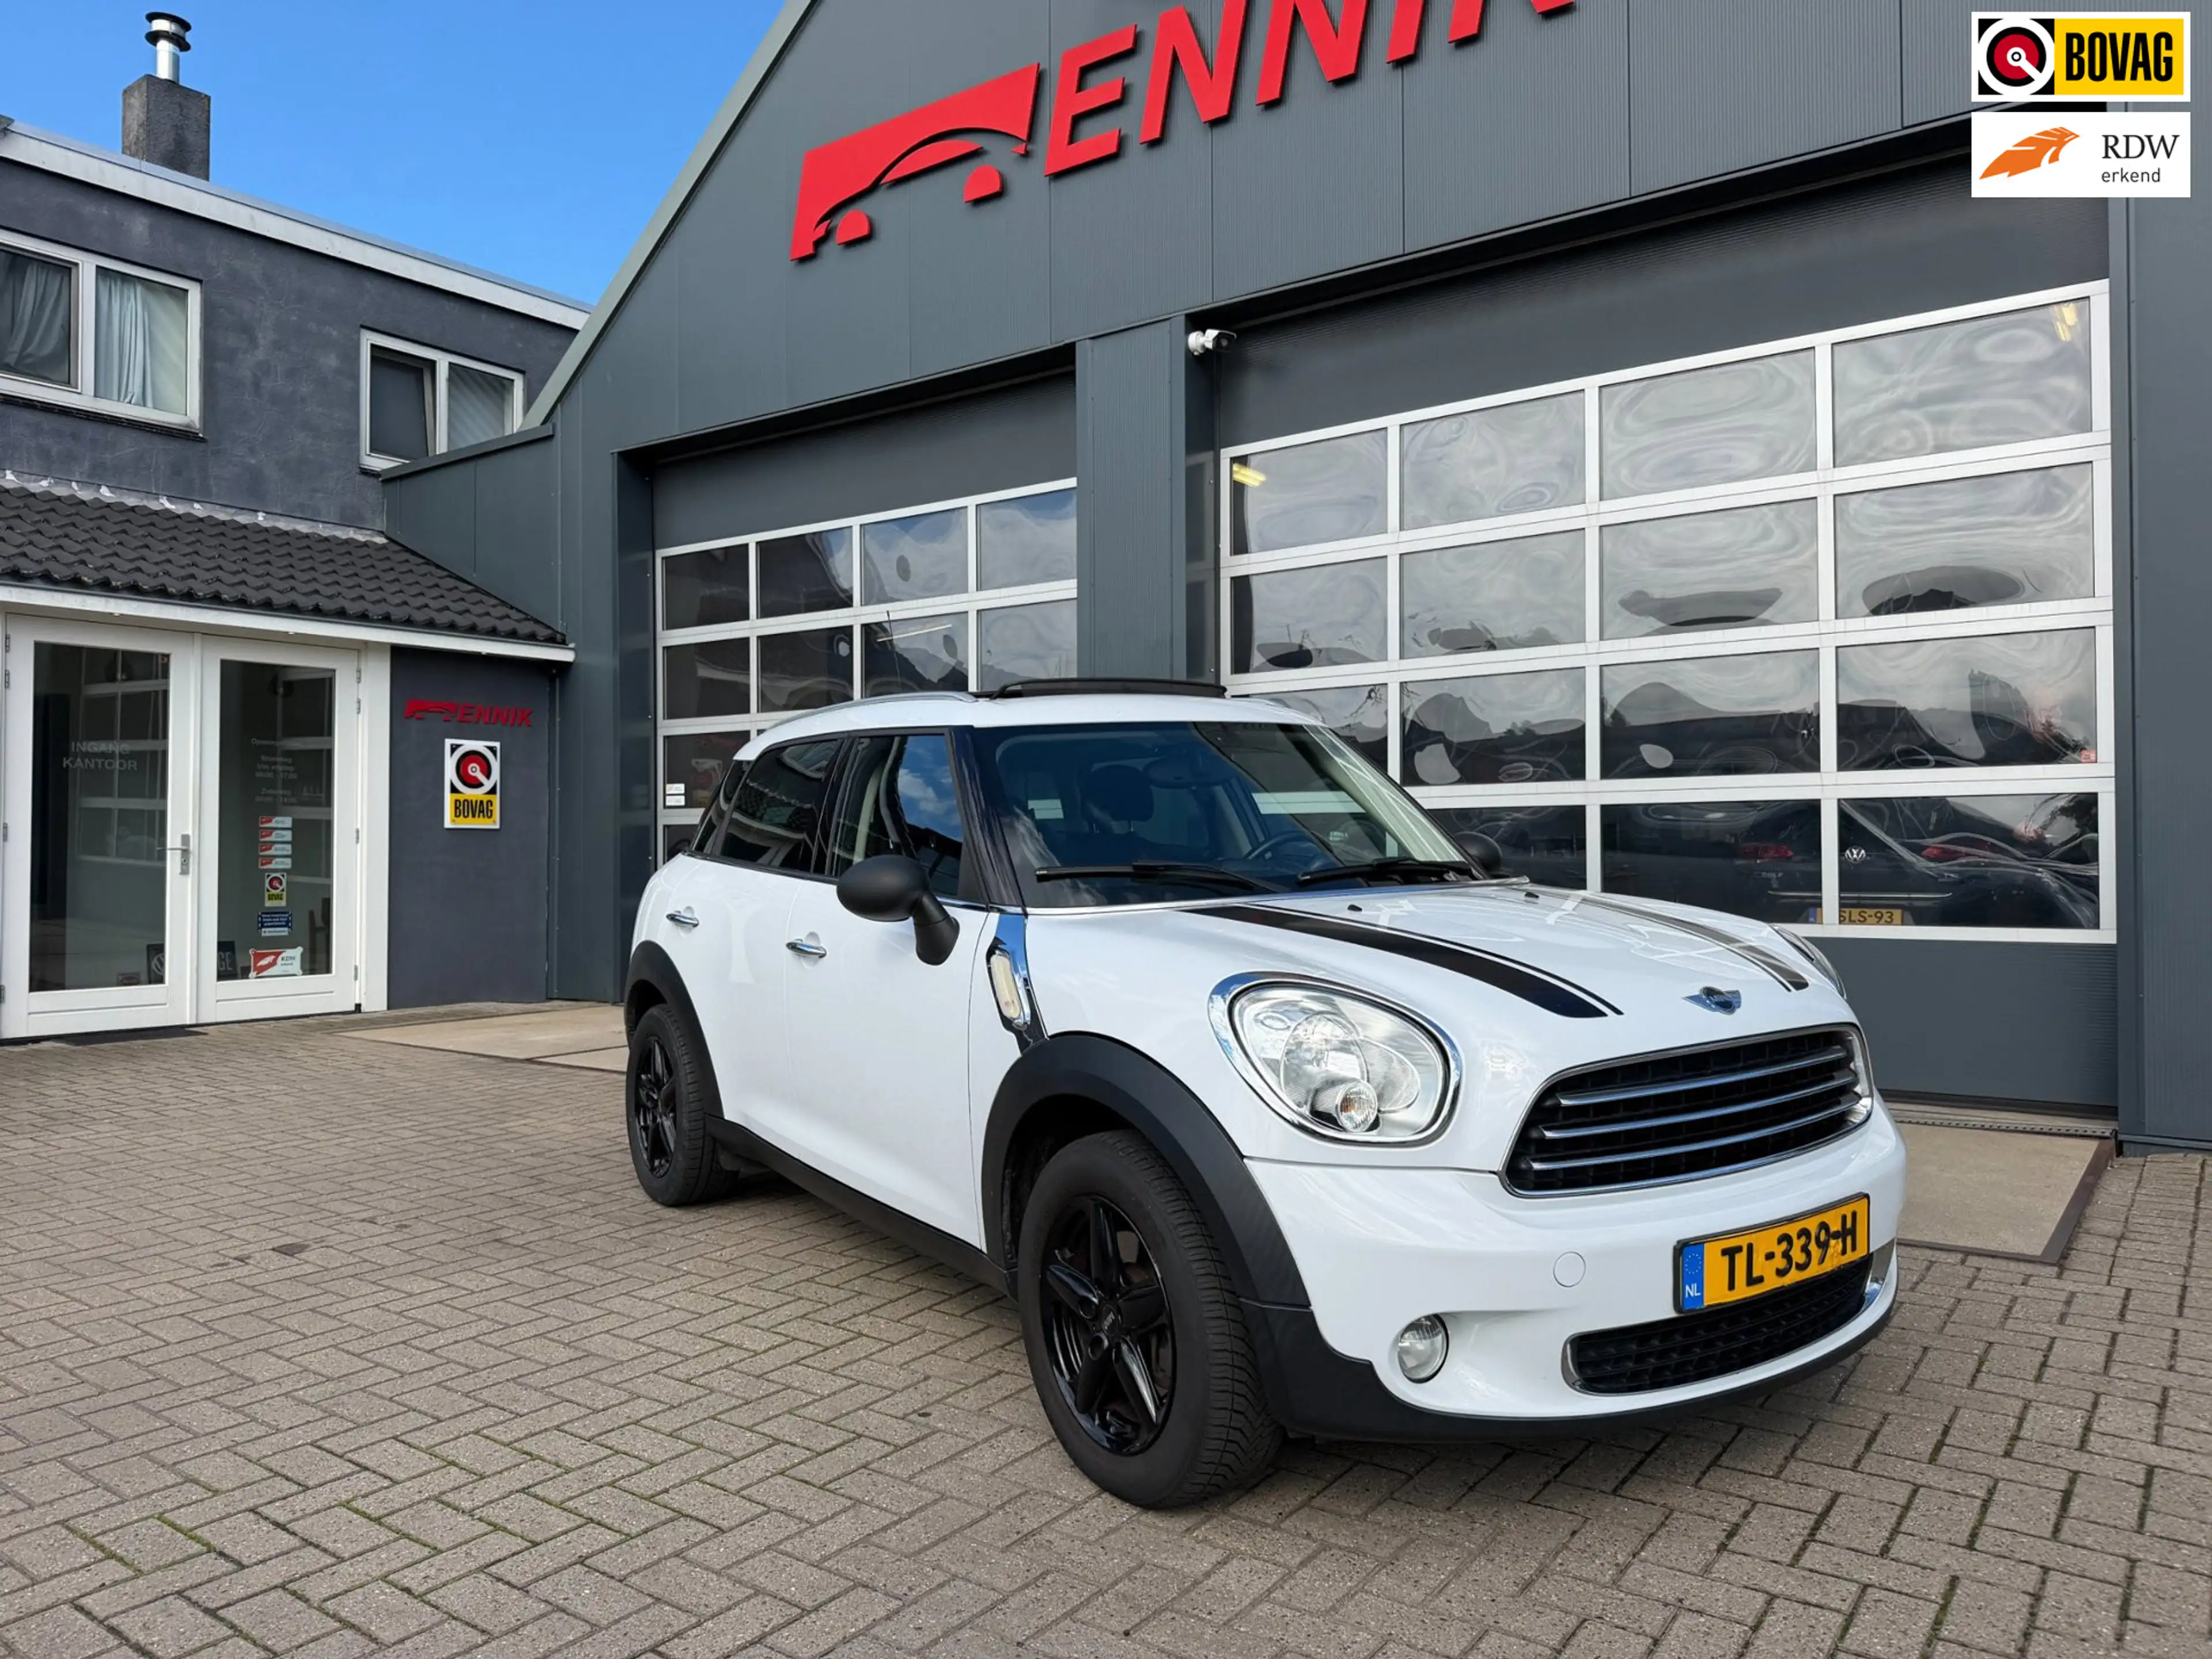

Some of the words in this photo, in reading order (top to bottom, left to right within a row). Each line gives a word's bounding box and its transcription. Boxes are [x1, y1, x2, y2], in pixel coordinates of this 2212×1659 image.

[457, 702, 533, 727] ENNIK
[71, 741, 130, 755] INGANG
[63, 757, 138, 771] KANTOOR
[454, 799, 494, 819] BOVAG
[1721, 1210, 1857, 1291] TL-339-H
[1685, 1282, 1701, 1298] NL
